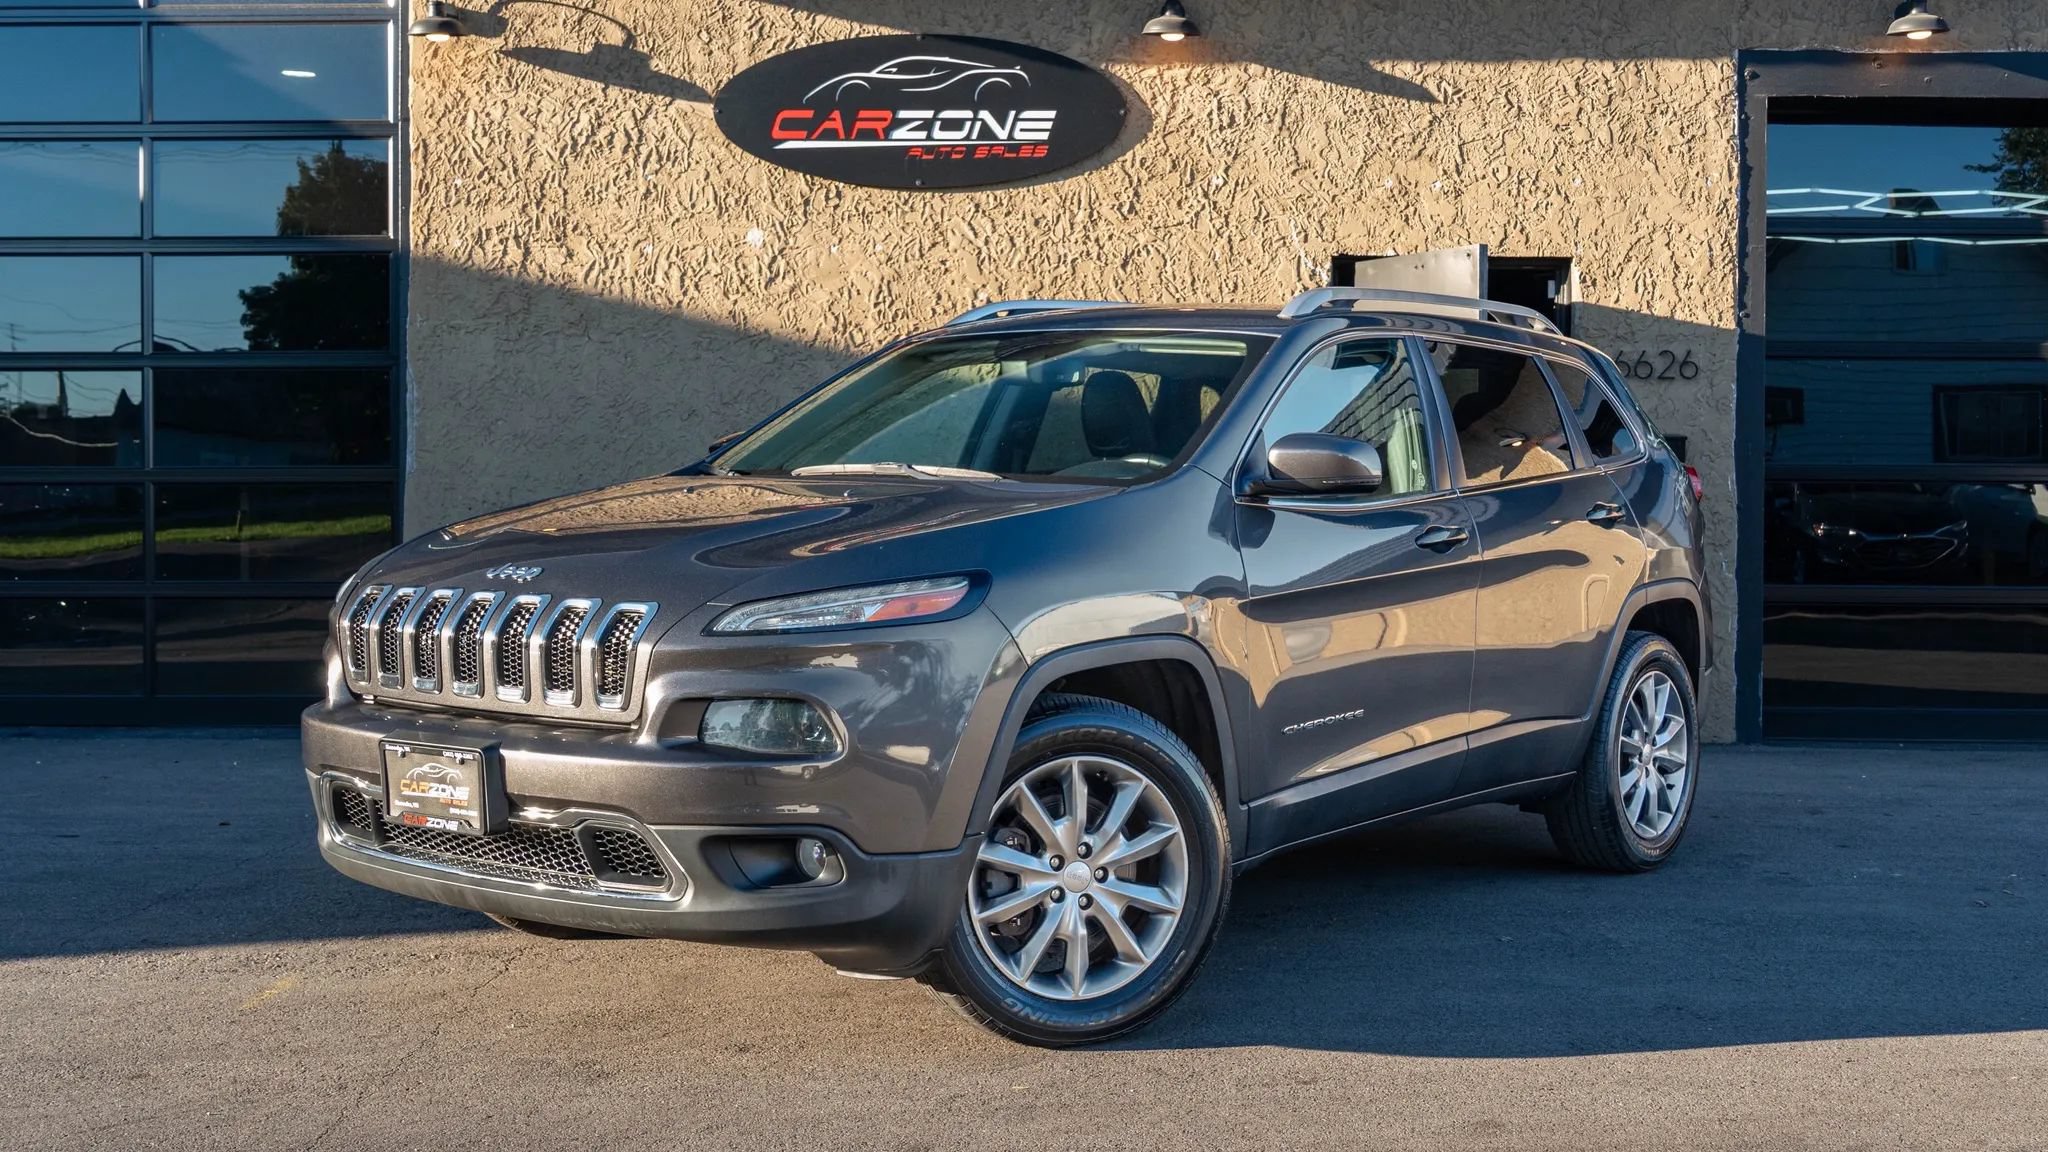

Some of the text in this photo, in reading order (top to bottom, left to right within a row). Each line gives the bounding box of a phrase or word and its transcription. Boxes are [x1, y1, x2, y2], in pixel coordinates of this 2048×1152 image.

[771, 109, 1057, 141] CARZONE
[908, 145, 1050, 159] AUTO SALES
[1615, 350, 1699, 380] 6626
[486, 562, 543, 583] Jeep
[1283, 709, 1364, 734] CHEROKEE
